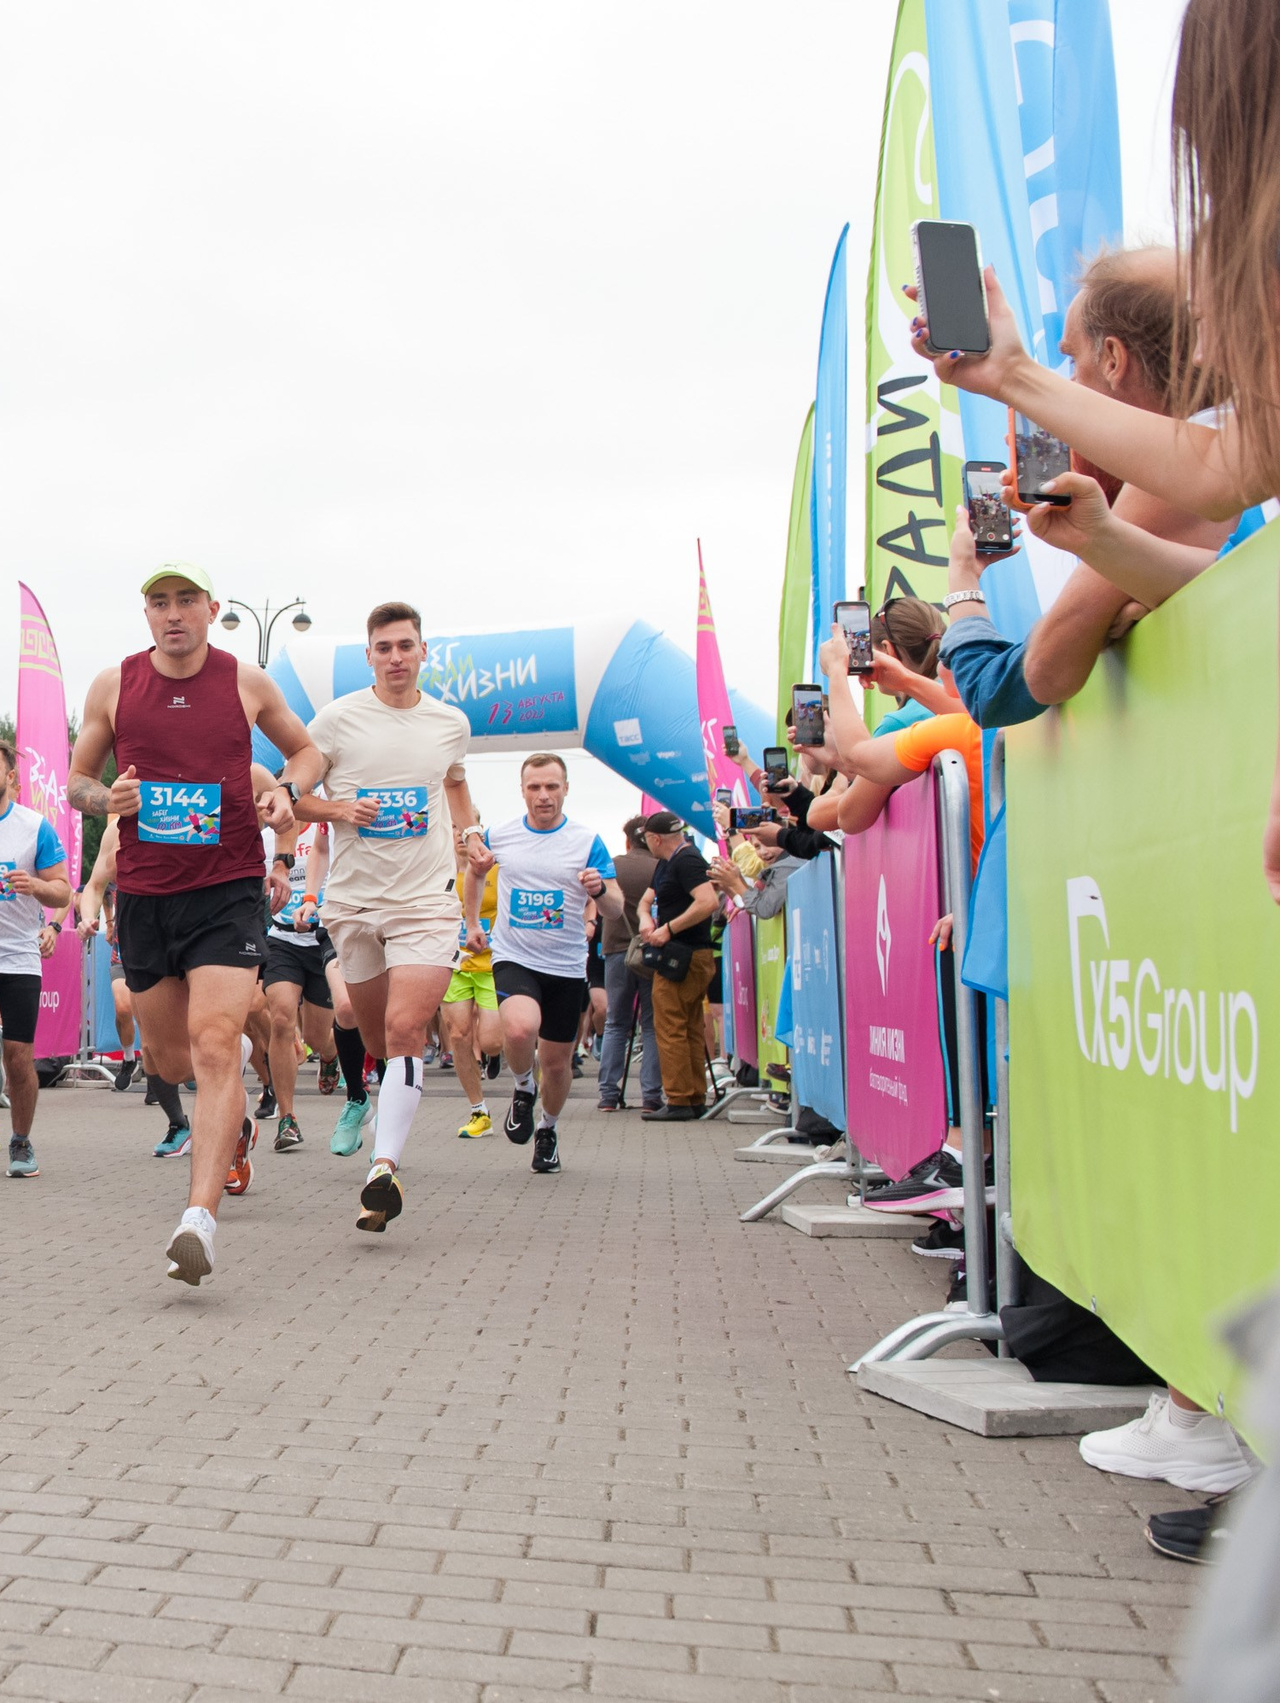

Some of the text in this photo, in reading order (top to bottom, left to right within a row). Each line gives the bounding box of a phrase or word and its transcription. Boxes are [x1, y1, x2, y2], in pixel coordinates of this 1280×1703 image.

[420, 642, 460, 672] ЕГ
[488, 691, 564, 724] 13 АВГУСТА
[519, 708, 544, 721] 2023
[150, 786, 208, 807] 3144
[518, 891, 554, 906] 3196
